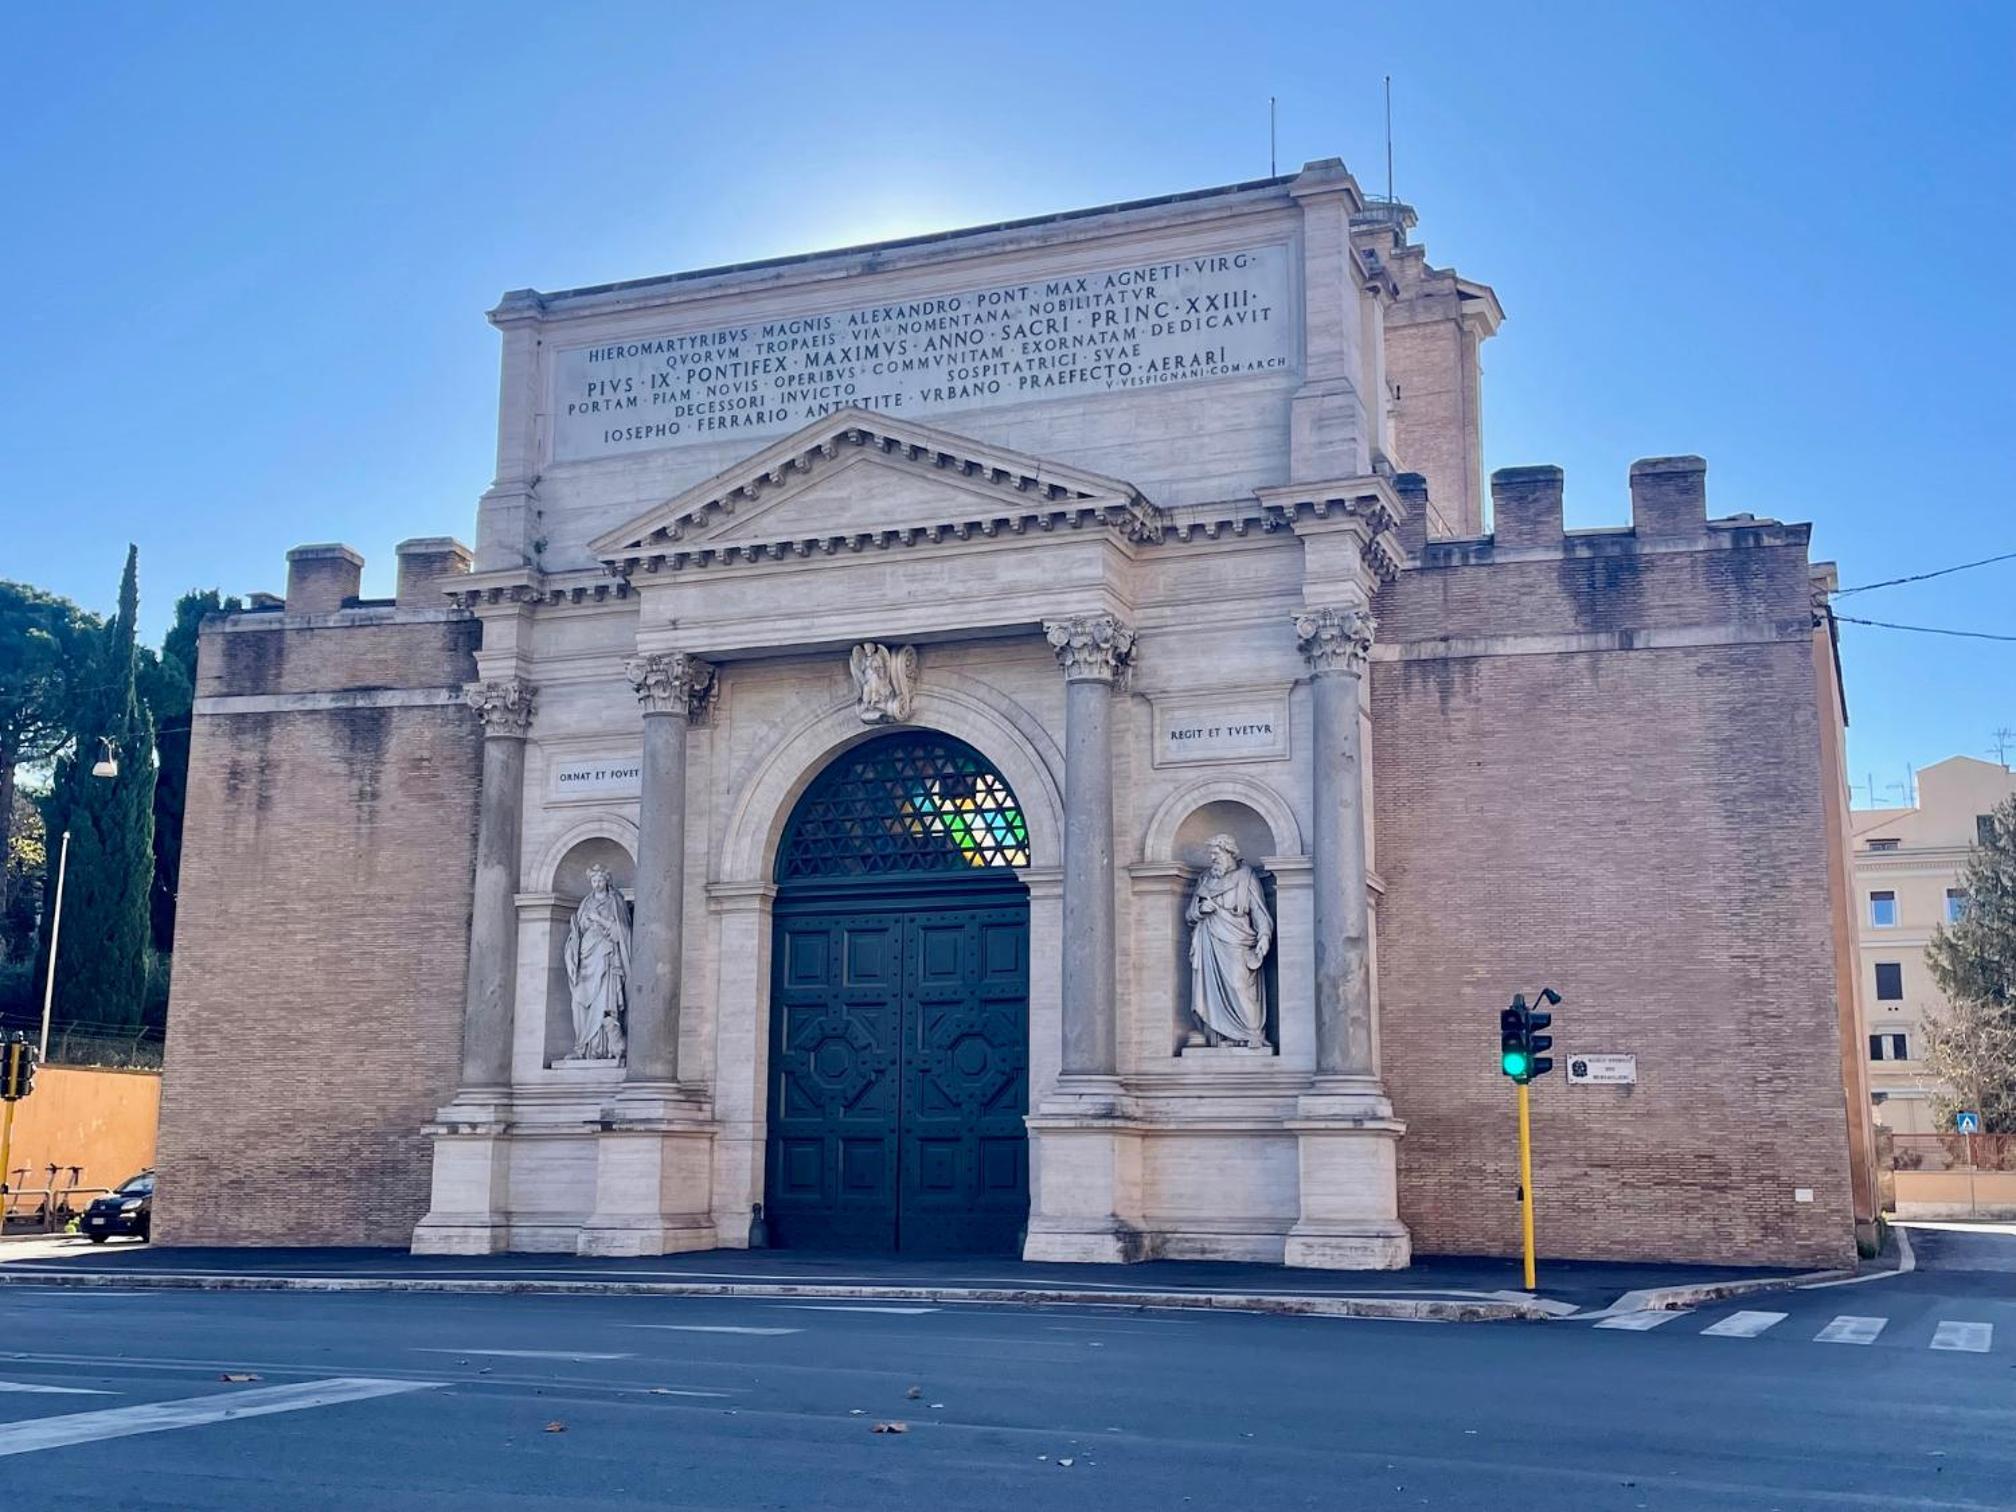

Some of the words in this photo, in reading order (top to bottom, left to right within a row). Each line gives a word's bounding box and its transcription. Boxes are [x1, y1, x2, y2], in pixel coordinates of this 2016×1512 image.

[587, 377, 633, 397] PIVS
[651, 372, 670, 389] IX
[686, 356, 788, 385] PONTIFEX
[805, 340, 907, 368] MAXIMVS
[924, 329, 985, 353] ANNO
[1001, 316, 1069, 341] SACRI
[1090, 301, 1170, 329] PRINC
[589, 329, 748, 363] HIEROMARTYRIBVS
[762, 316, 831, 338] MAGNIS
[848, 298, 961, 327] ALEXANDRO
[978, 287, 1029, 307] PONT
[1046, 278, 1087, 298] MAX
[1105, 264, 1179, 289] AGNETI
[666, 347, 739, 370] QVORVM
[755, 333, 836, 356] TROPAEIS
[851, 327, 881, 341] VIA
[898, 308, 1011, 336] NOMENTANA
[1030, 286, 1157, 317] NOBILITATVR
[569, 396, 638, 416] PORTAM
[653, 389, 692, 405] PIAM
[706, 379, 759, 398] NOVIS
[774, 366, 856, 388] OPERIBVS
[872, 346, 1004, 375] COMMVNITAM
[1022, 327, 1136, 355] EXORNATAM
[1151, 307, 1272, 337] DEDICAVIT
[604, 422, 681, 443] IOSEPHO
[698, 408, 788, 432] FERRARIO
[920, 380, 1001, 402] VRBANO
[1019, 362, 1132, 391] PRAEFECTO
[1147, 346, 1224, 373] AERARI
[675, 395, 765, 418] DECESSORI
[781, 383, 856, 404] INVICTO
[947, 353, 1077, 382] SOSPITATRICI
[1094, 344, 1141, 362] SVAE
[559, 771, 592, 782] ORNAT
[595, 770, 606, 780] ET
[1170, 729, 1204, 741] REGIT
[1208, 727, 1221, 738] ET
[1227, 724, 1273, 737] TVETVR
